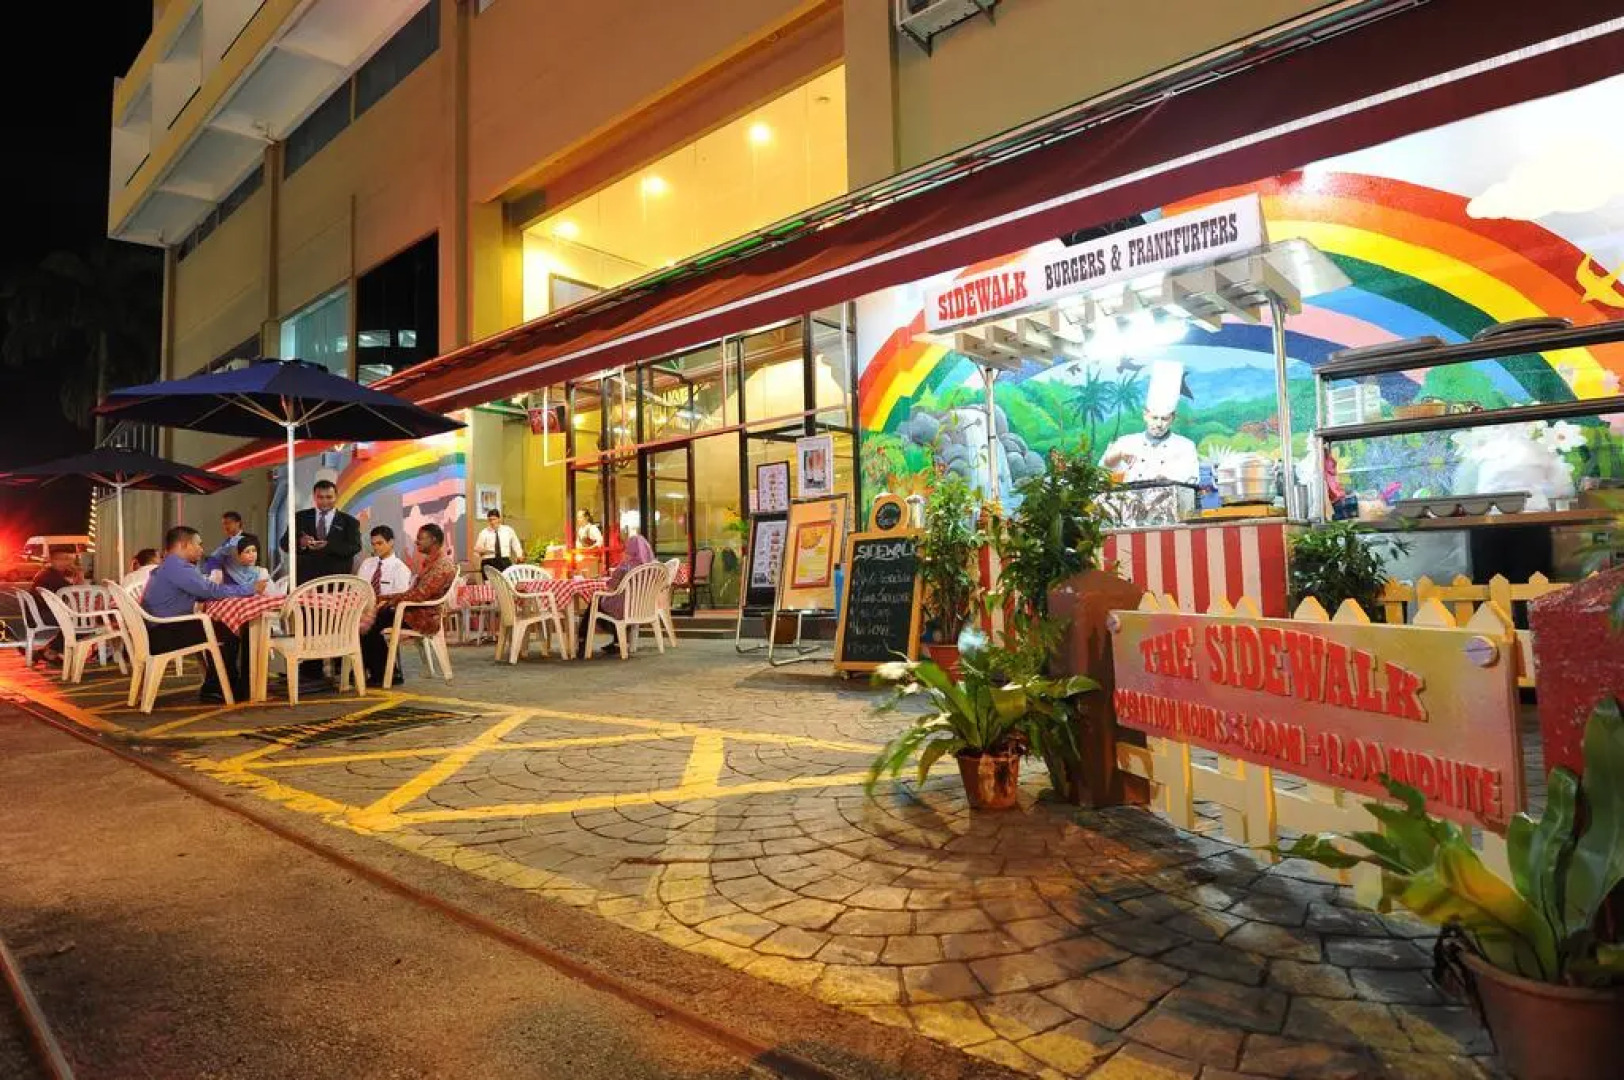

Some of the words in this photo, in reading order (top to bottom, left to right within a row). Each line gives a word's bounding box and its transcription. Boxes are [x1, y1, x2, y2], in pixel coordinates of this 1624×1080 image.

[938, 271, 1028, 321] SIDEWALK
[1044, 249, 1106, 291] BURGERS
[1111, 244, 1122, 271] &
[1128, 213, 1238, 267] FRANKFURTERS
[1139, 625, 1199, 680] THE
[1204, 624, 1429, 722] SIDEWALK
[1387, 748, 1501, 818] MIDNITE
